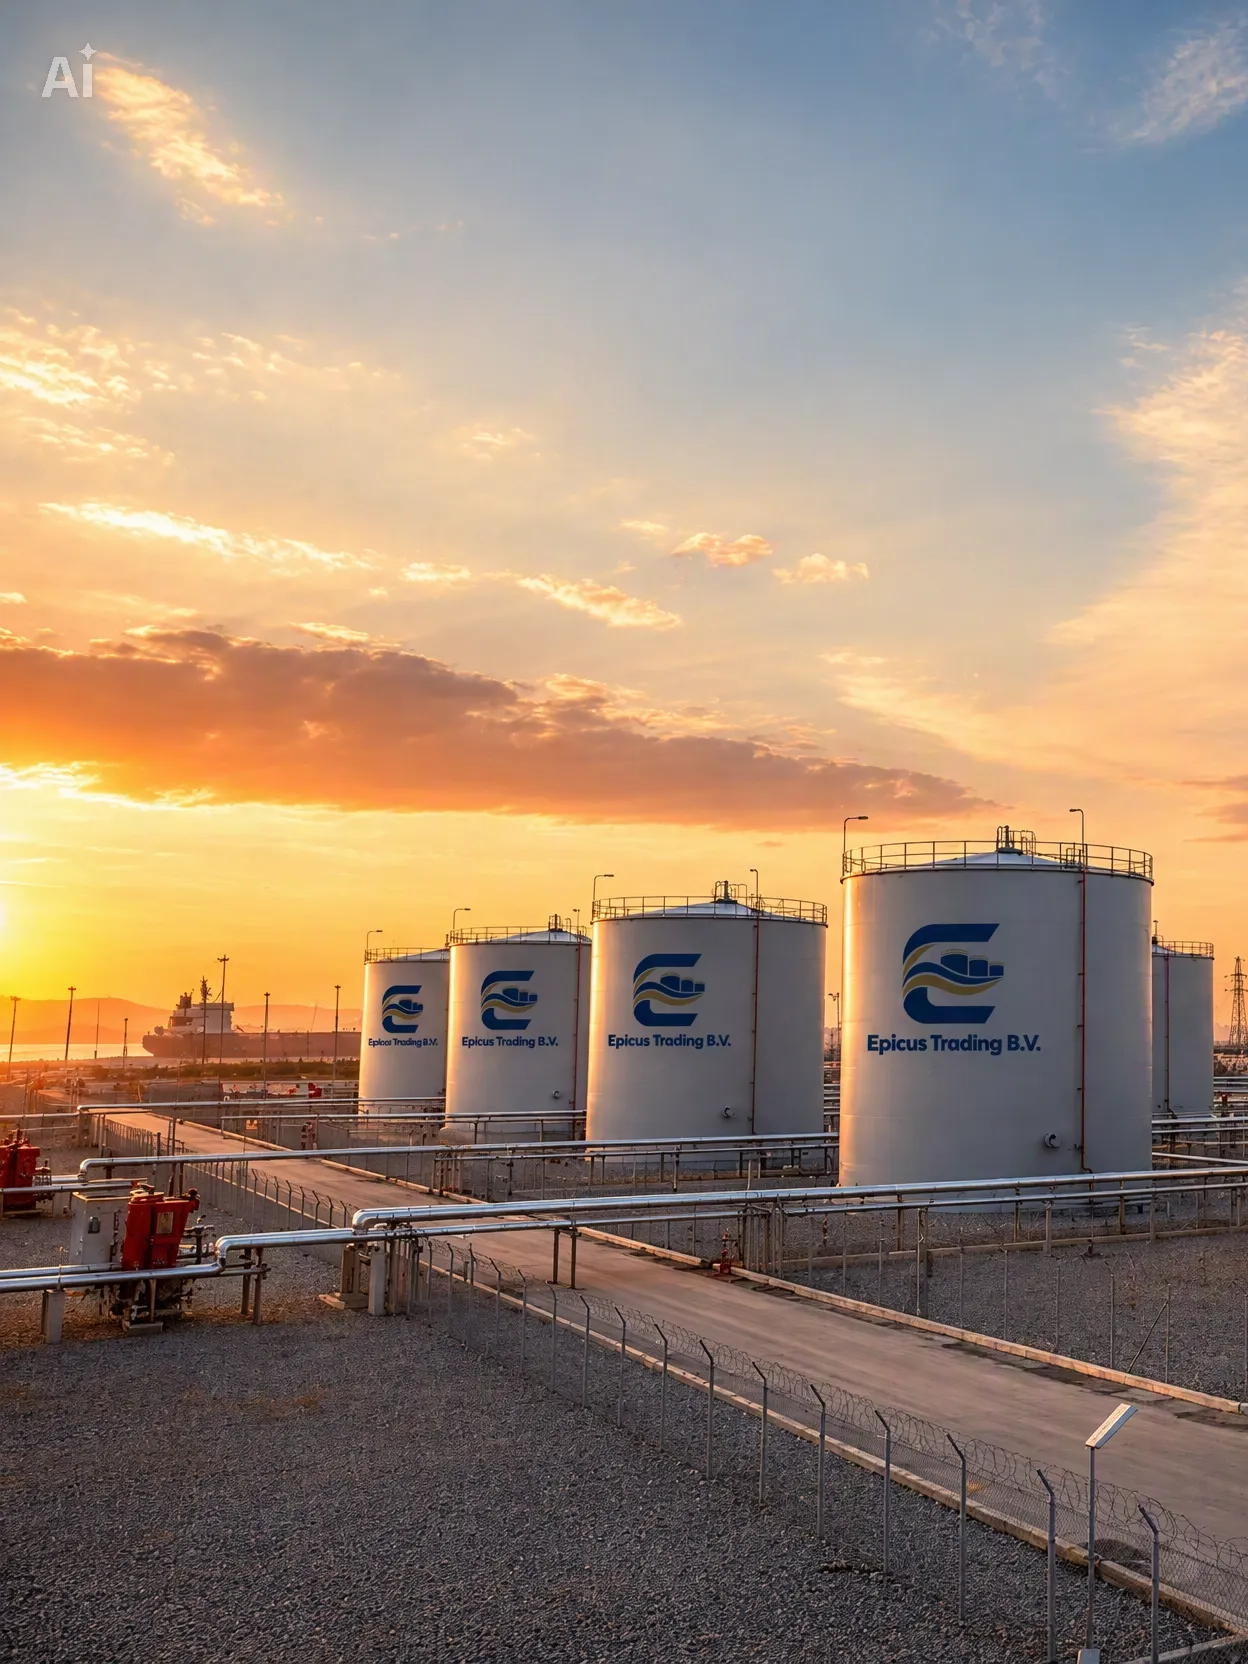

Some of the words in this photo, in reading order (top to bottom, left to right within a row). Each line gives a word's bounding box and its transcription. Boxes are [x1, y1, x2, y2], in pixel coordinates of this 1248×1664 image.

[462, 1036, 495, 1048] Epicus
[496, 1036, 536, 1049] Trading
[537, 1036, 559, 1047] B.V.
[608, 1034, 650, 1049] Epicus
[653, 1034, 704, 1050] Trading
[706, 1034, 731, 1047] B.V.
[867, 1033, 928, 1055] Epicus
[930, 1033, 1003, 1056] Trading
[1007, 1034, 1042, 1052] B.V.
